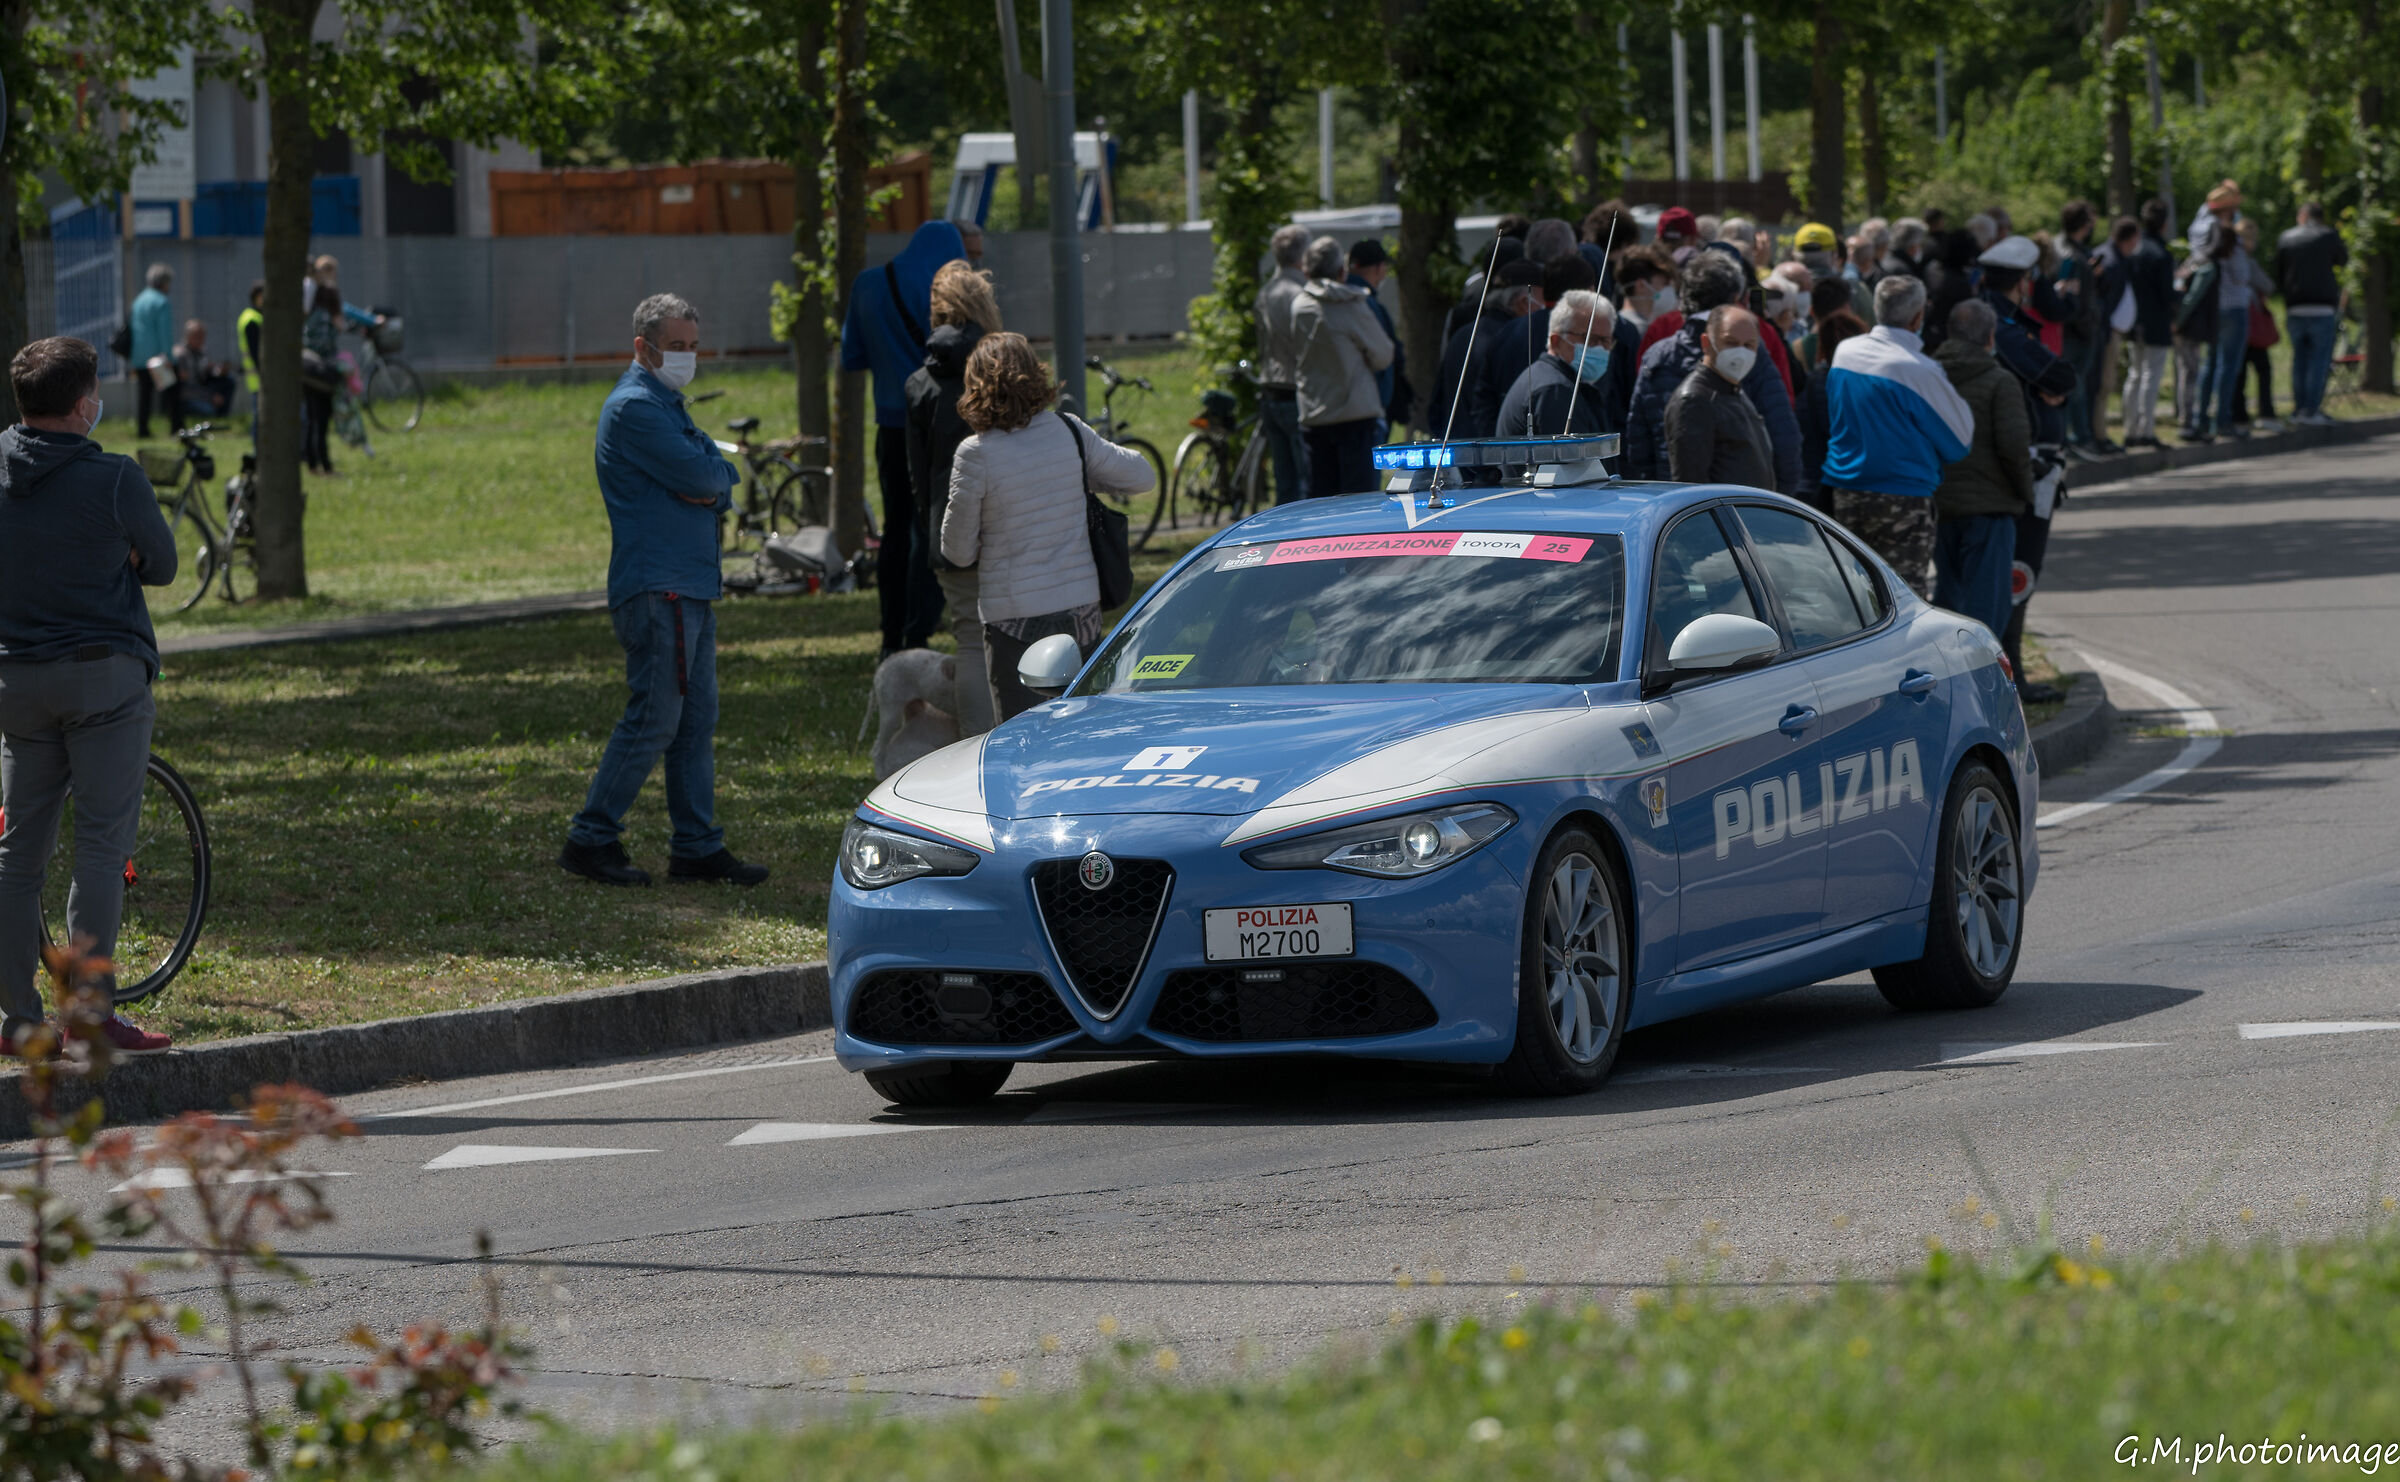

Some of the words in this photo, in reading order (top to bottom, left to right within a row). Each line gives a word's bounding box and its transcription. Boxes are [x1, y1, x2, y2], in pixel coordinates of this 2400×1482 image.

[1276, 539, 1455, 557] ORGANIZZAZIONE
[1461, 540, 1521, 549] TOYOTA
[1542, 542, 1571, 553] 25
[1137, 659, 1184, 673] RACE
[1152, 753, 1174, 767] 1
[1020, 774, 1260, 798] POLIZIA
[1713, 737, 1924, 861] POLIZIA
[1237, 908, 1319, 928] POLIZIA
[1240, 929, 1320, 957] M2700
